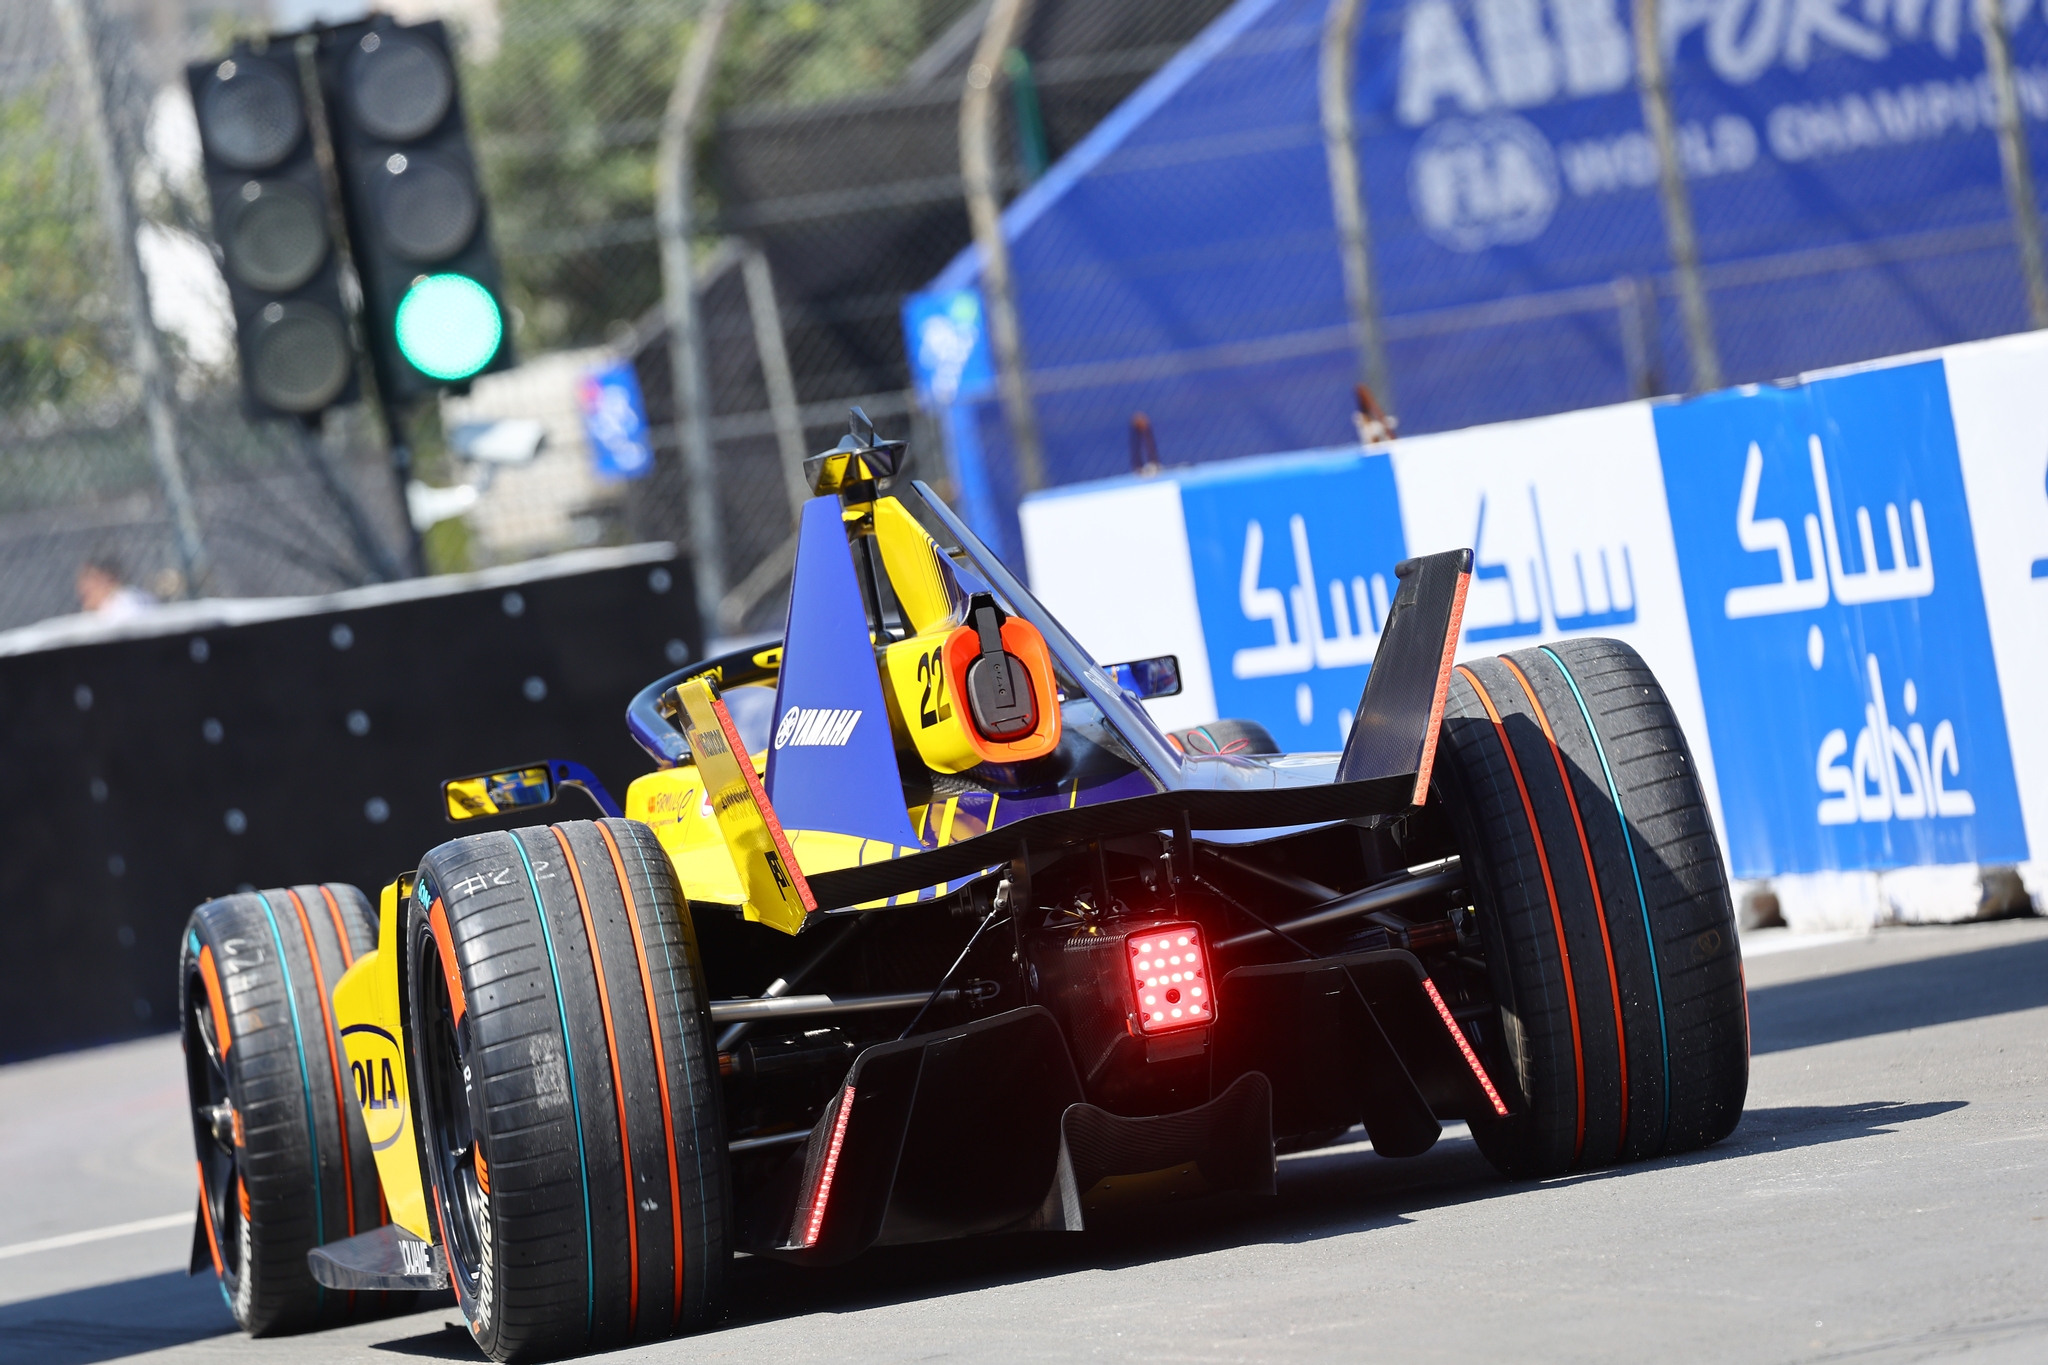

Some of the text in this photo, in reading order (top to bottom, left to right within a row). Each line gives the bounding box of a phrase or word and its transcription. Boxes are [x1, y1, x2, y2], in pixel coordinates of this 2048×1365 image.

[1560, 116, 1760, 196] WOLD
[789, 708, 863, 746] YAMAHA
[917, 645, 953, 729] 22
